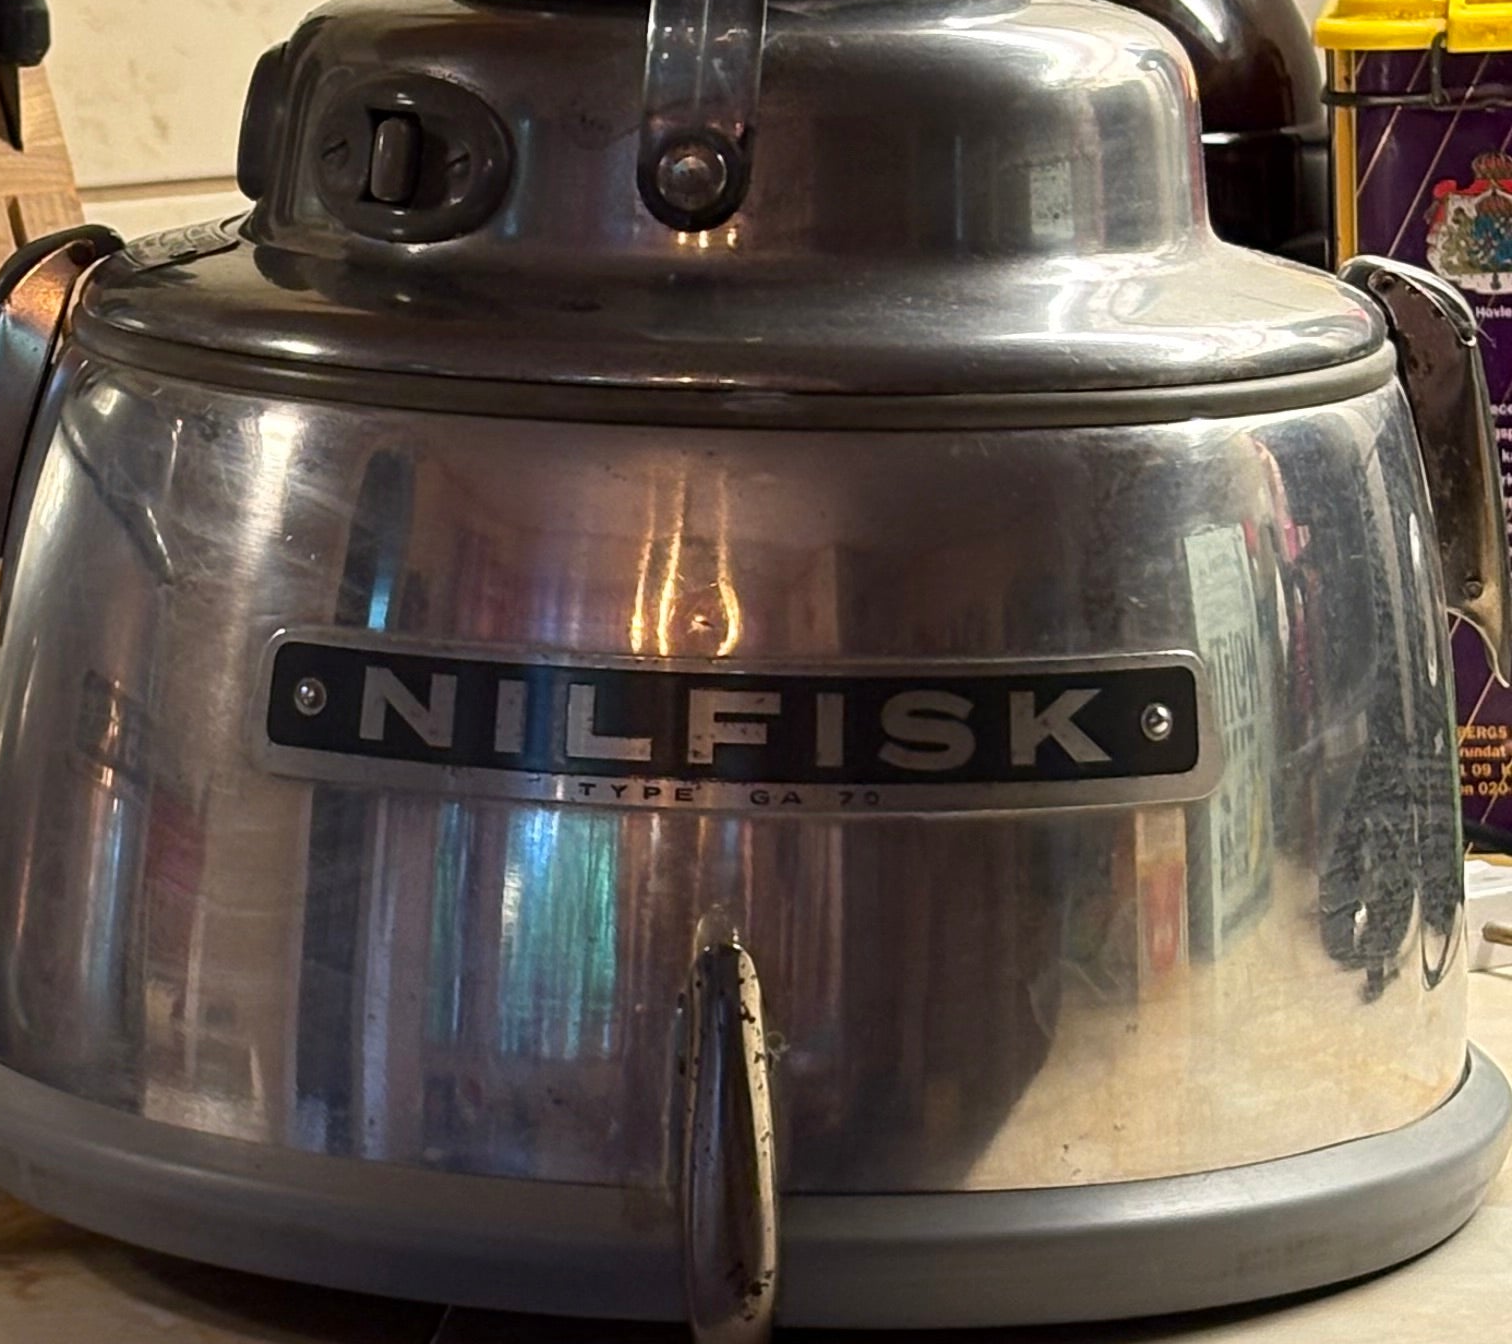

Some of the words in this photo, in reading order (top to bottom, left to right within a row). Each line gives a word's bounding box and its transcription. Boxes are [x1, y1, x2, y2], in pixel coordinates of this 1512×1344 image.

[357, 664, 1113, 771] NILFISK
[578, 781, 695, 803] TYPE
[749, 790, 802, 806] GA
[838, 790, 881, 806] 70
